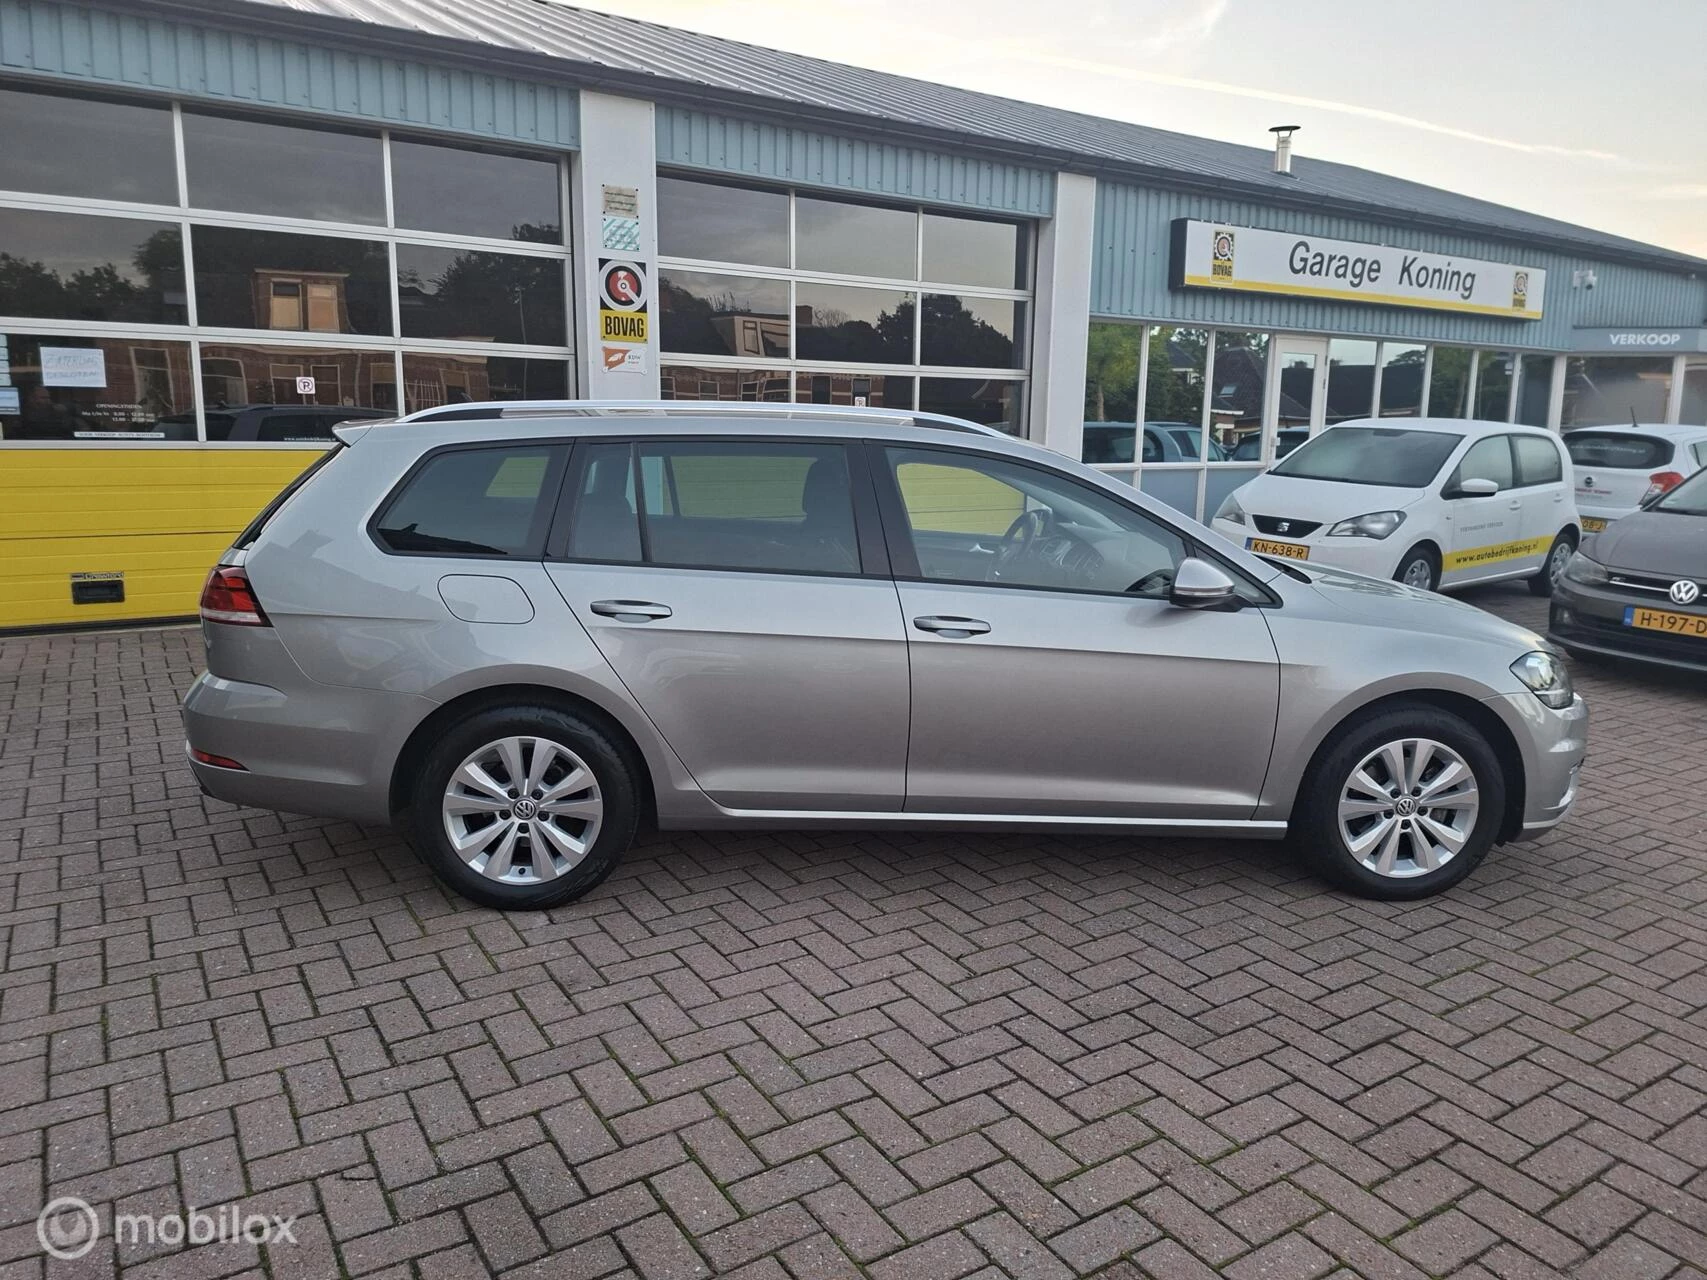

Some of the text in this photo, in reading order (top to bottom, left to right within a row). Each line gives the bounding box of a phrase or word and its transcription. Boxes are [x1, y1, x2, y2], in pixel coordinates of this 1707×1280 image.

[1212, 263, 1233, 277] BOVAG
[1288, 240, 1477, 300] Garage Koning
[604, 315, 645, 338] BOVAG
[1609, 333, 1681, 345] VERKOOP
[1252, 541, 1305, 560] KN-638-R
